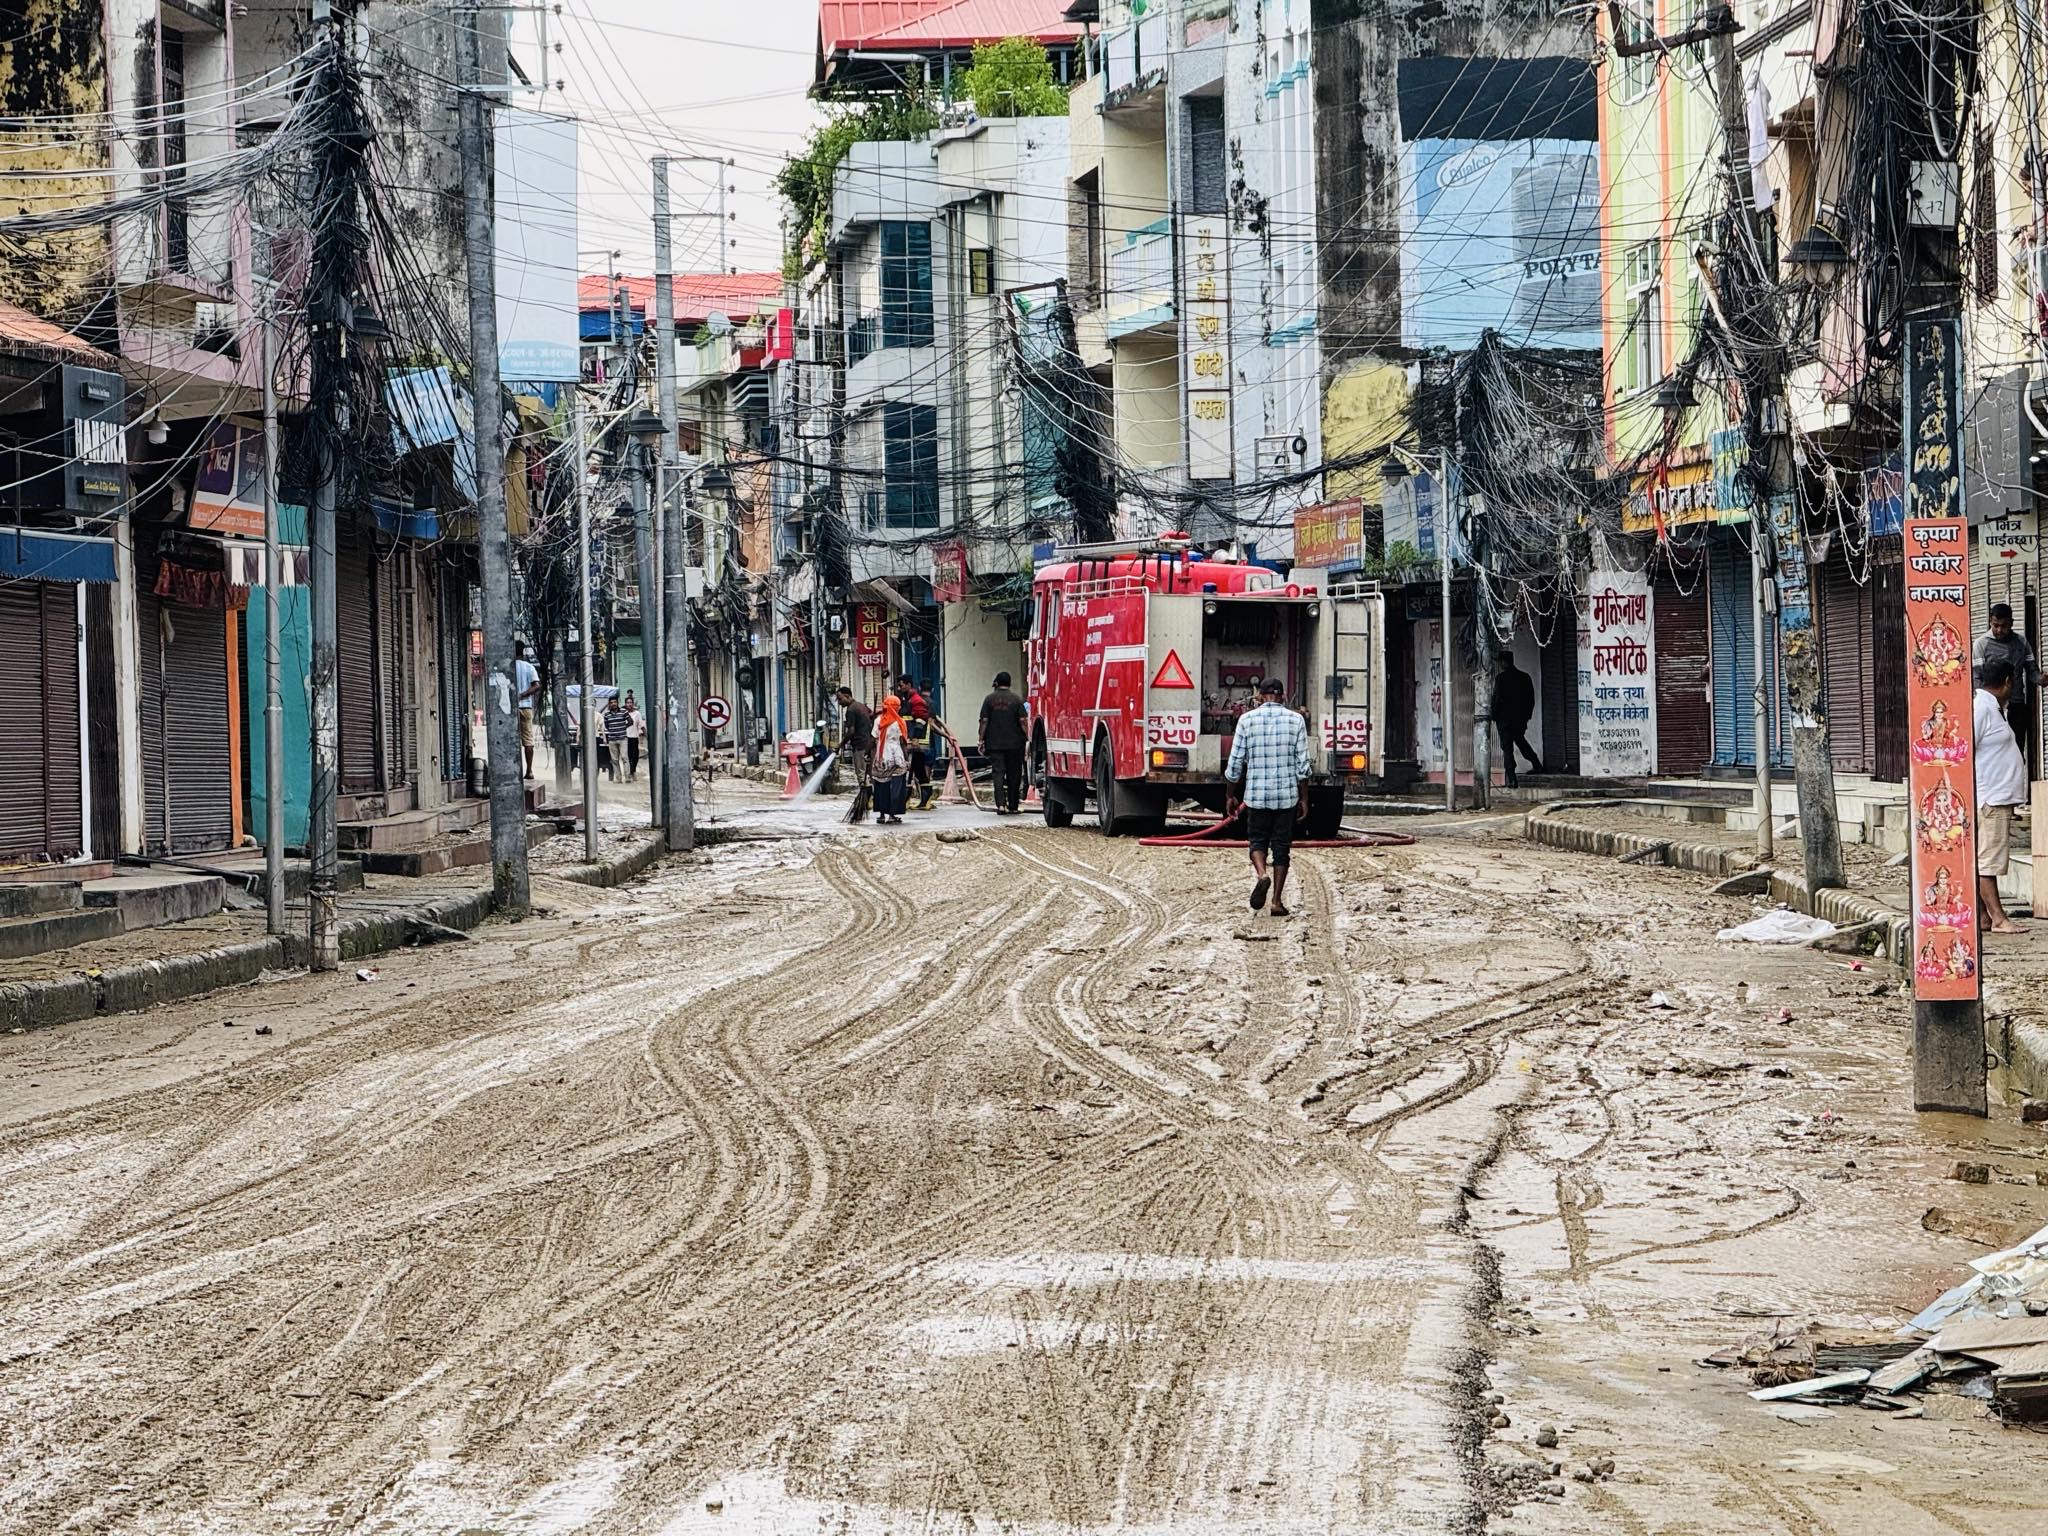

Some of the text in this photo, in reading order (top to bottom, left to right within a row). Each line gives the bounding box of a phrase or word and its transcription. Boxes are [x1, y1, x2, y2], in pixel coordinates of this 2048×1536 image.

[1912, 526, 1960, 548] कृपया
[1910, 551, 1963, 575] फोहोर
[1909, 585, 1966, 606] नफाल्नु
[1594, 636, 1647, 676] कस्मेटिक
[1594, 682, 1645, 701] थोक तथा
